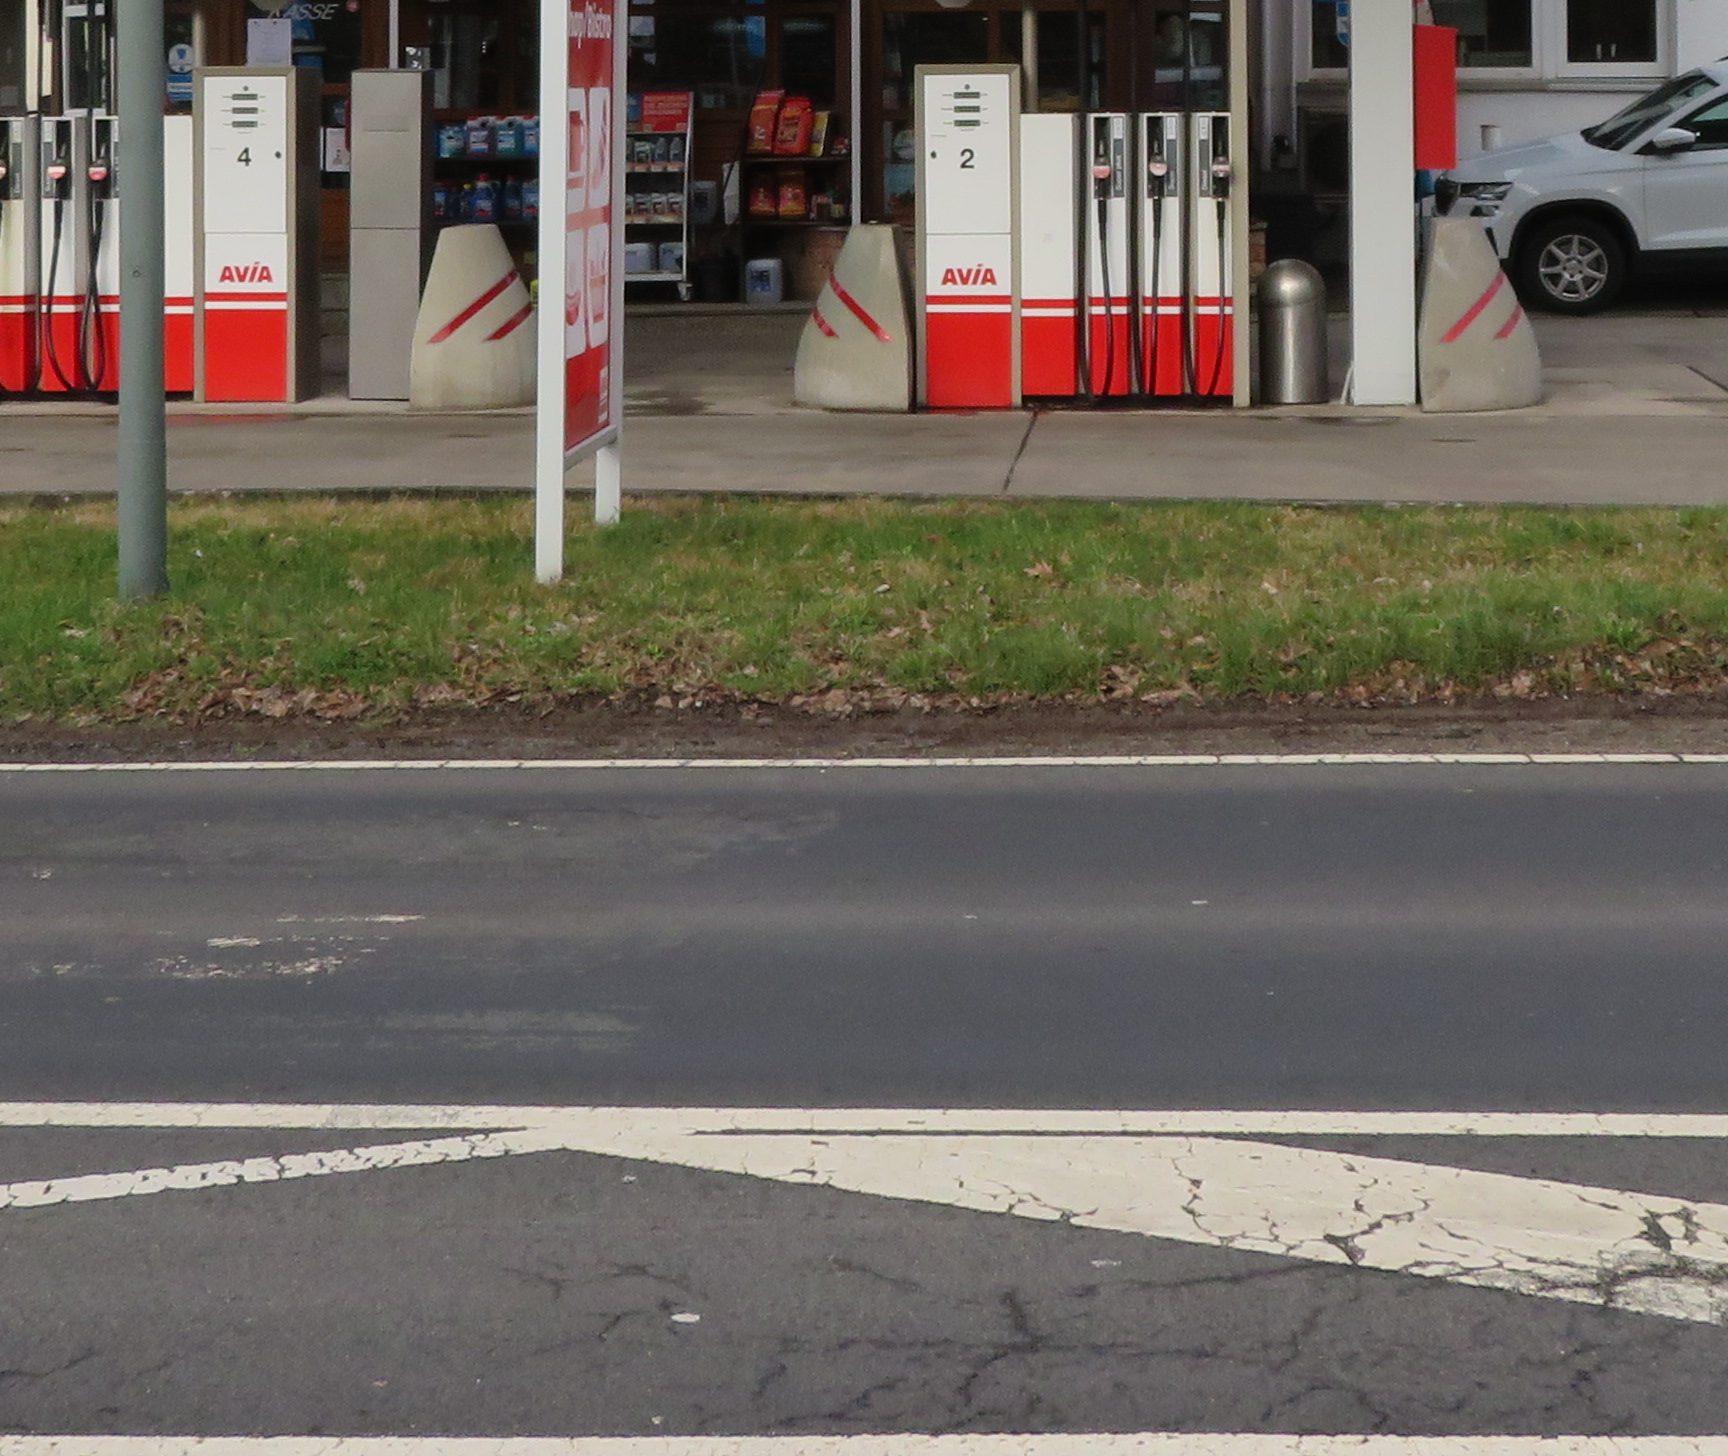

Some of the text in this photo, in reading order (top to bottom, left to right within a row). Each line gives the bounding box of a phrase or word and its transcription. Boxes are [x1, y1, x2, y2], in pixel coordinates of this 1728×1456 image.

[568, 0, 612, 49] hop/Bistro
[237, 147, 252, 167] 4
[960, 148, 975, 169] 2
[219, 262, 273, 283] AVIA
[941, 263, 998, 285] AVIA
